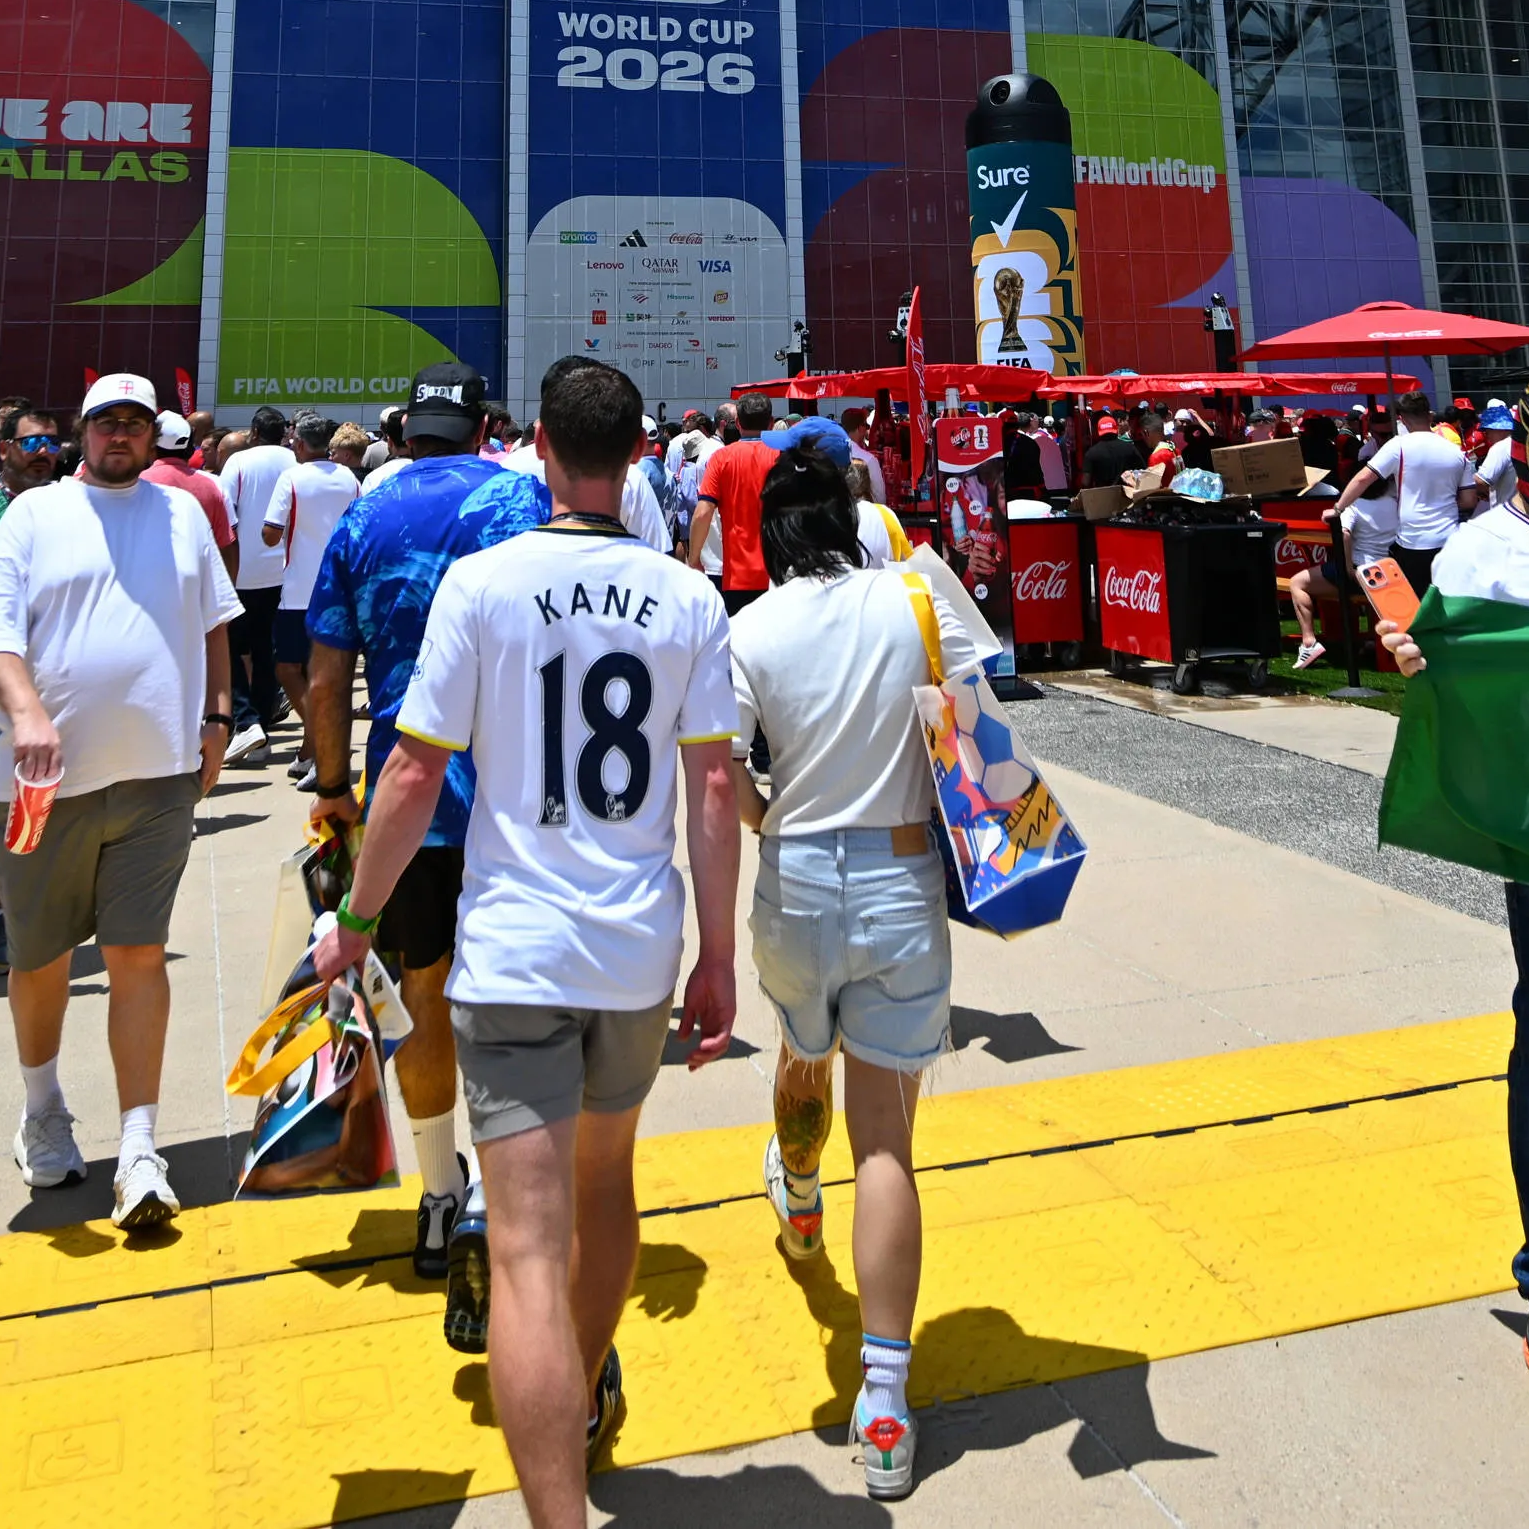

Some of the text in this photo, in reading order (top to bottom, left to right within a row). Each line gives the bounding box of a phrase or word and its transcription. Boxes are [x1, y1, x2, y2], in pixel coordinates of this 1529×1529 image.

[558, 11, 755, 45] WORLD CUP
[557, 46, 756, 95] 2026
[977, 165, 1030, 189] Sure
[587, 260, 625, 270] Lenovo
[641, 257, 678, 269] QATAR
[698, 260, 732, 273] VISA
[234, 377, 281, 395] FIFA
[285, 377, 365, 395] WORLD
[369, 377, 410, 394] CUP
[1105, 566, 1162, 613] Coca-Cola
[533, 582, 659, 629] KANE
[534, 647, 655, 828] 18
